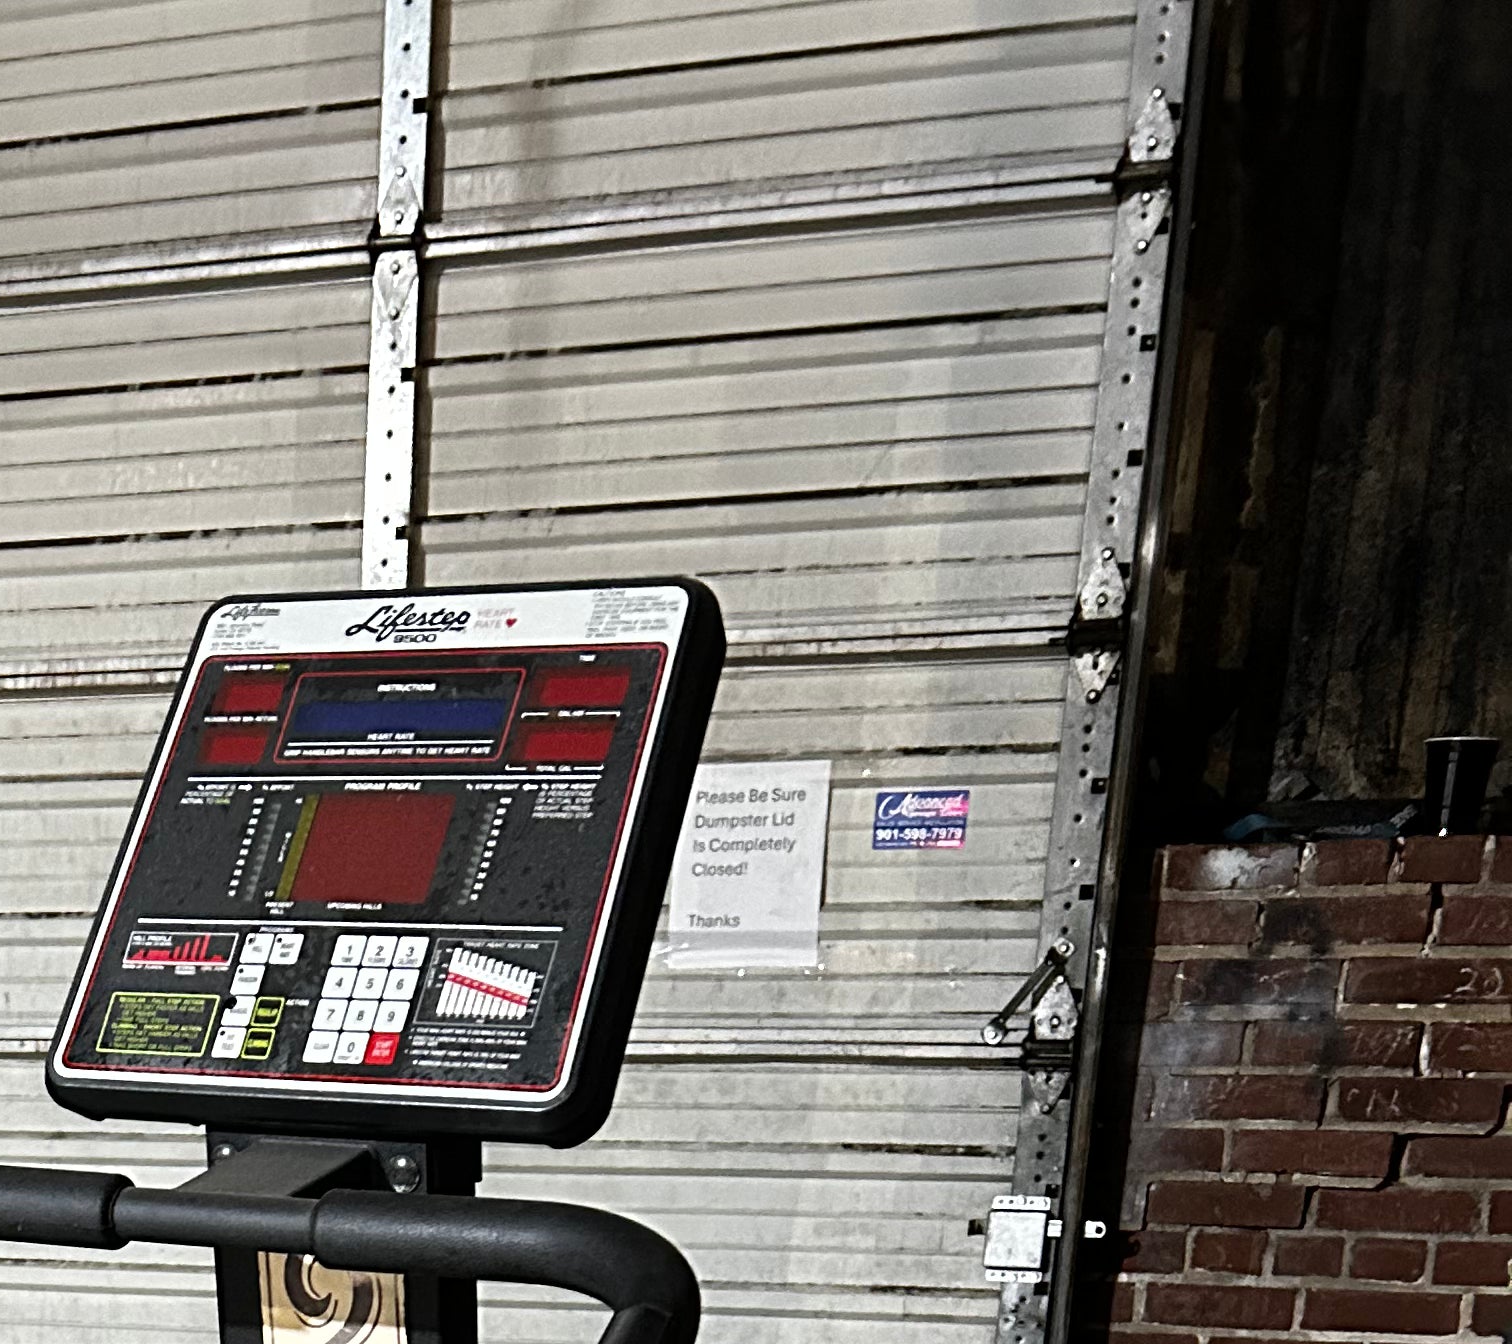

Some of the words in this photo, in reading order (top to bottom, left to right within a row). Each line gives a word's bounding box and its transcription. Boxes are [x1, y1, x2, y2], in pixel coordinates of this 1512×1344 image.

[345, 603, 471, 642] Lifestep
[474, 620, 501, 629] RATE
[393, 634, 437, 643] 9500
[395, 732, 415, 740] RATE
[345, 782, 385, 791] PROGRAM
[387, 782, 422, 790] PROFILE
[696, 790, 746, 804] Please
[749, 788, 769, 803] Be
[771, 788, 807, 802] Sure
[695, 814, 769, 830] Dumpster
[772, 812, 795, 827] Lid
[876, 828, 963, 840] 901-598-7979
[694, 839, 705, 853] Is
[709, 837, 796, 853] Completely
[692, 862, 748, 877] Closed!
[688, 914, 740, 928] Thanks
[347, 945, 353, 955] 1
[375, 945, 384, 956] 2
[406, 946, 415, 957] 3
[335, 977, 344, 987] 4
[365, 978, 375, 989] 5
[395, 978, 405, 990] 6
[326, 1009, 336, 1020] 7
[387, 1011, 396, 1022] 9
[347, 1041, 356, 1053] 0
